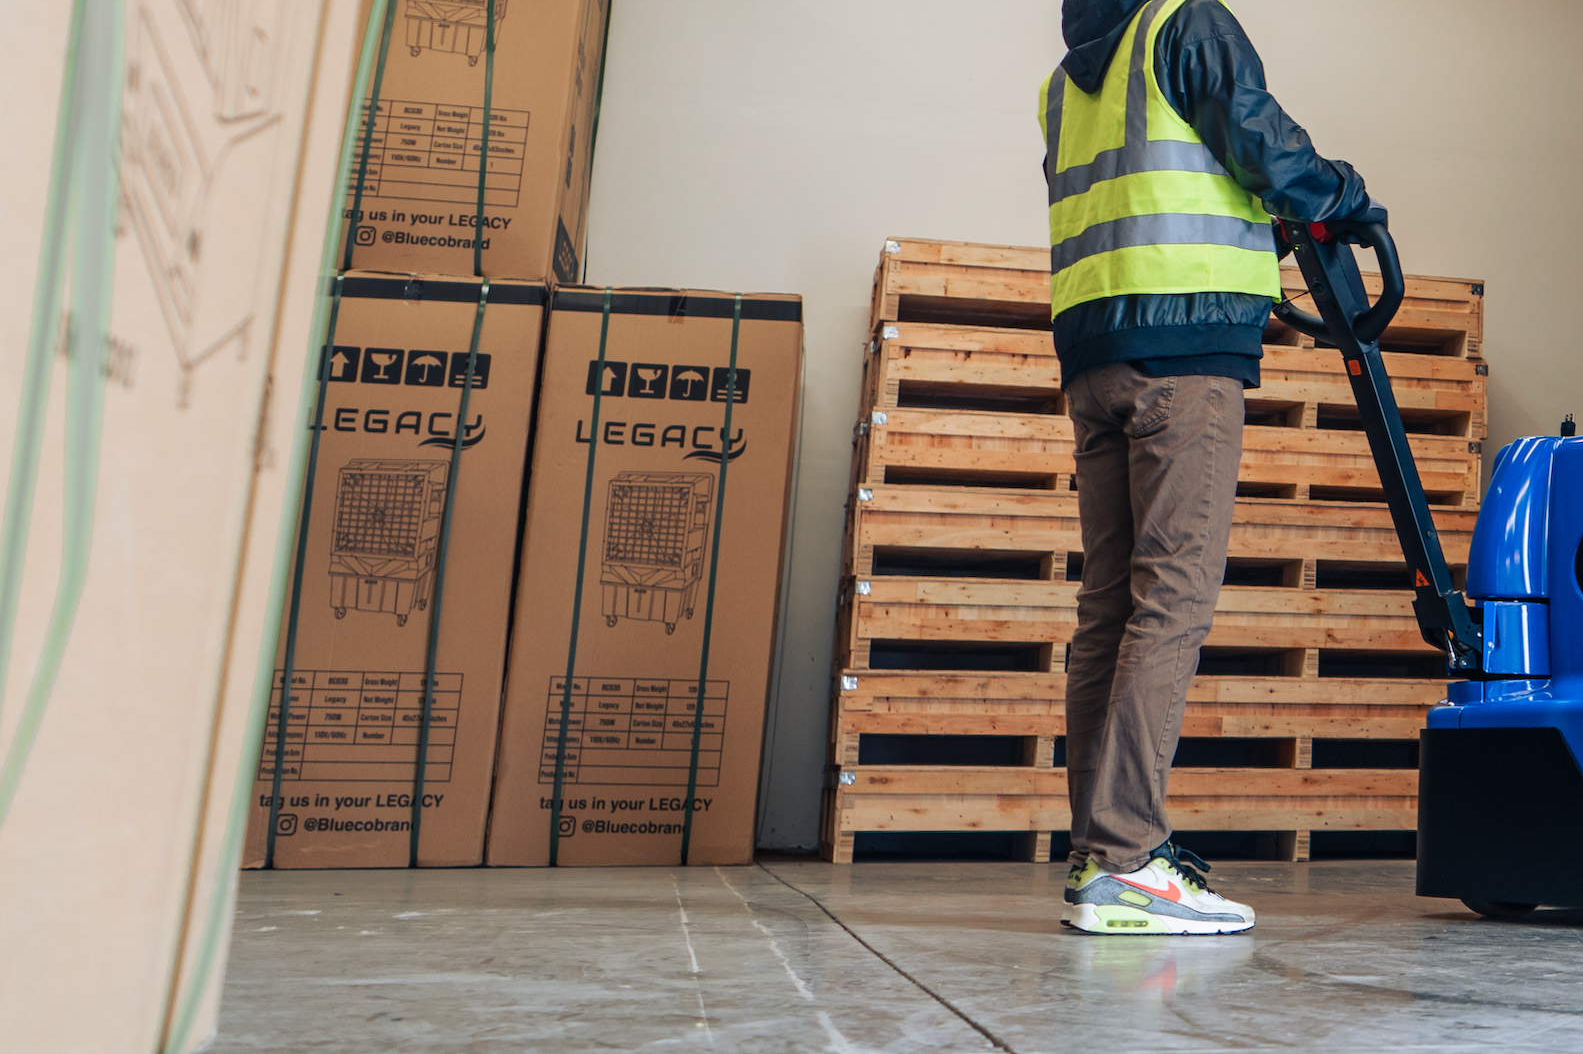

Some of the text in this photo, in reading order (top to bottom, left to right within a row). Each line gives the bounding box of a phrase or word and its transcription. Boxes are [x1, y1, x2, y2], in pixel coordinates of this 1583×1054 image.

[452, 111, 468, 119] Weight
[400, 122, 421, 132] Legacy
[447, 126, 465, 135] Weight
[436, 157, 456, 165] Number
[369, 211, 387, 222] us
[392, 209, 405, 222] in
[410, 215, 444, 225] your
[380, 678, 398, 686] Weight
[650, 685, 667, 694] Weight
[324, 695, 346, 704] Legacy
[375, 697, 394, 705] Weight
[599, 702, 619, 710] Legacy
[645, 703, 664, 711] Weight
[362, 732, 385, 740] Number
[635, 737, 656, 745] Number
[290, 796, 309, 807] us
[314, 794, 329, 807] in
[334, 798, 371, 810] your
[568, 798, 587, 810] us
[592, 796, 605, 810] in
[610, 800, 645, 813] your
[304, 817, 416, 832] @Bluecobran
